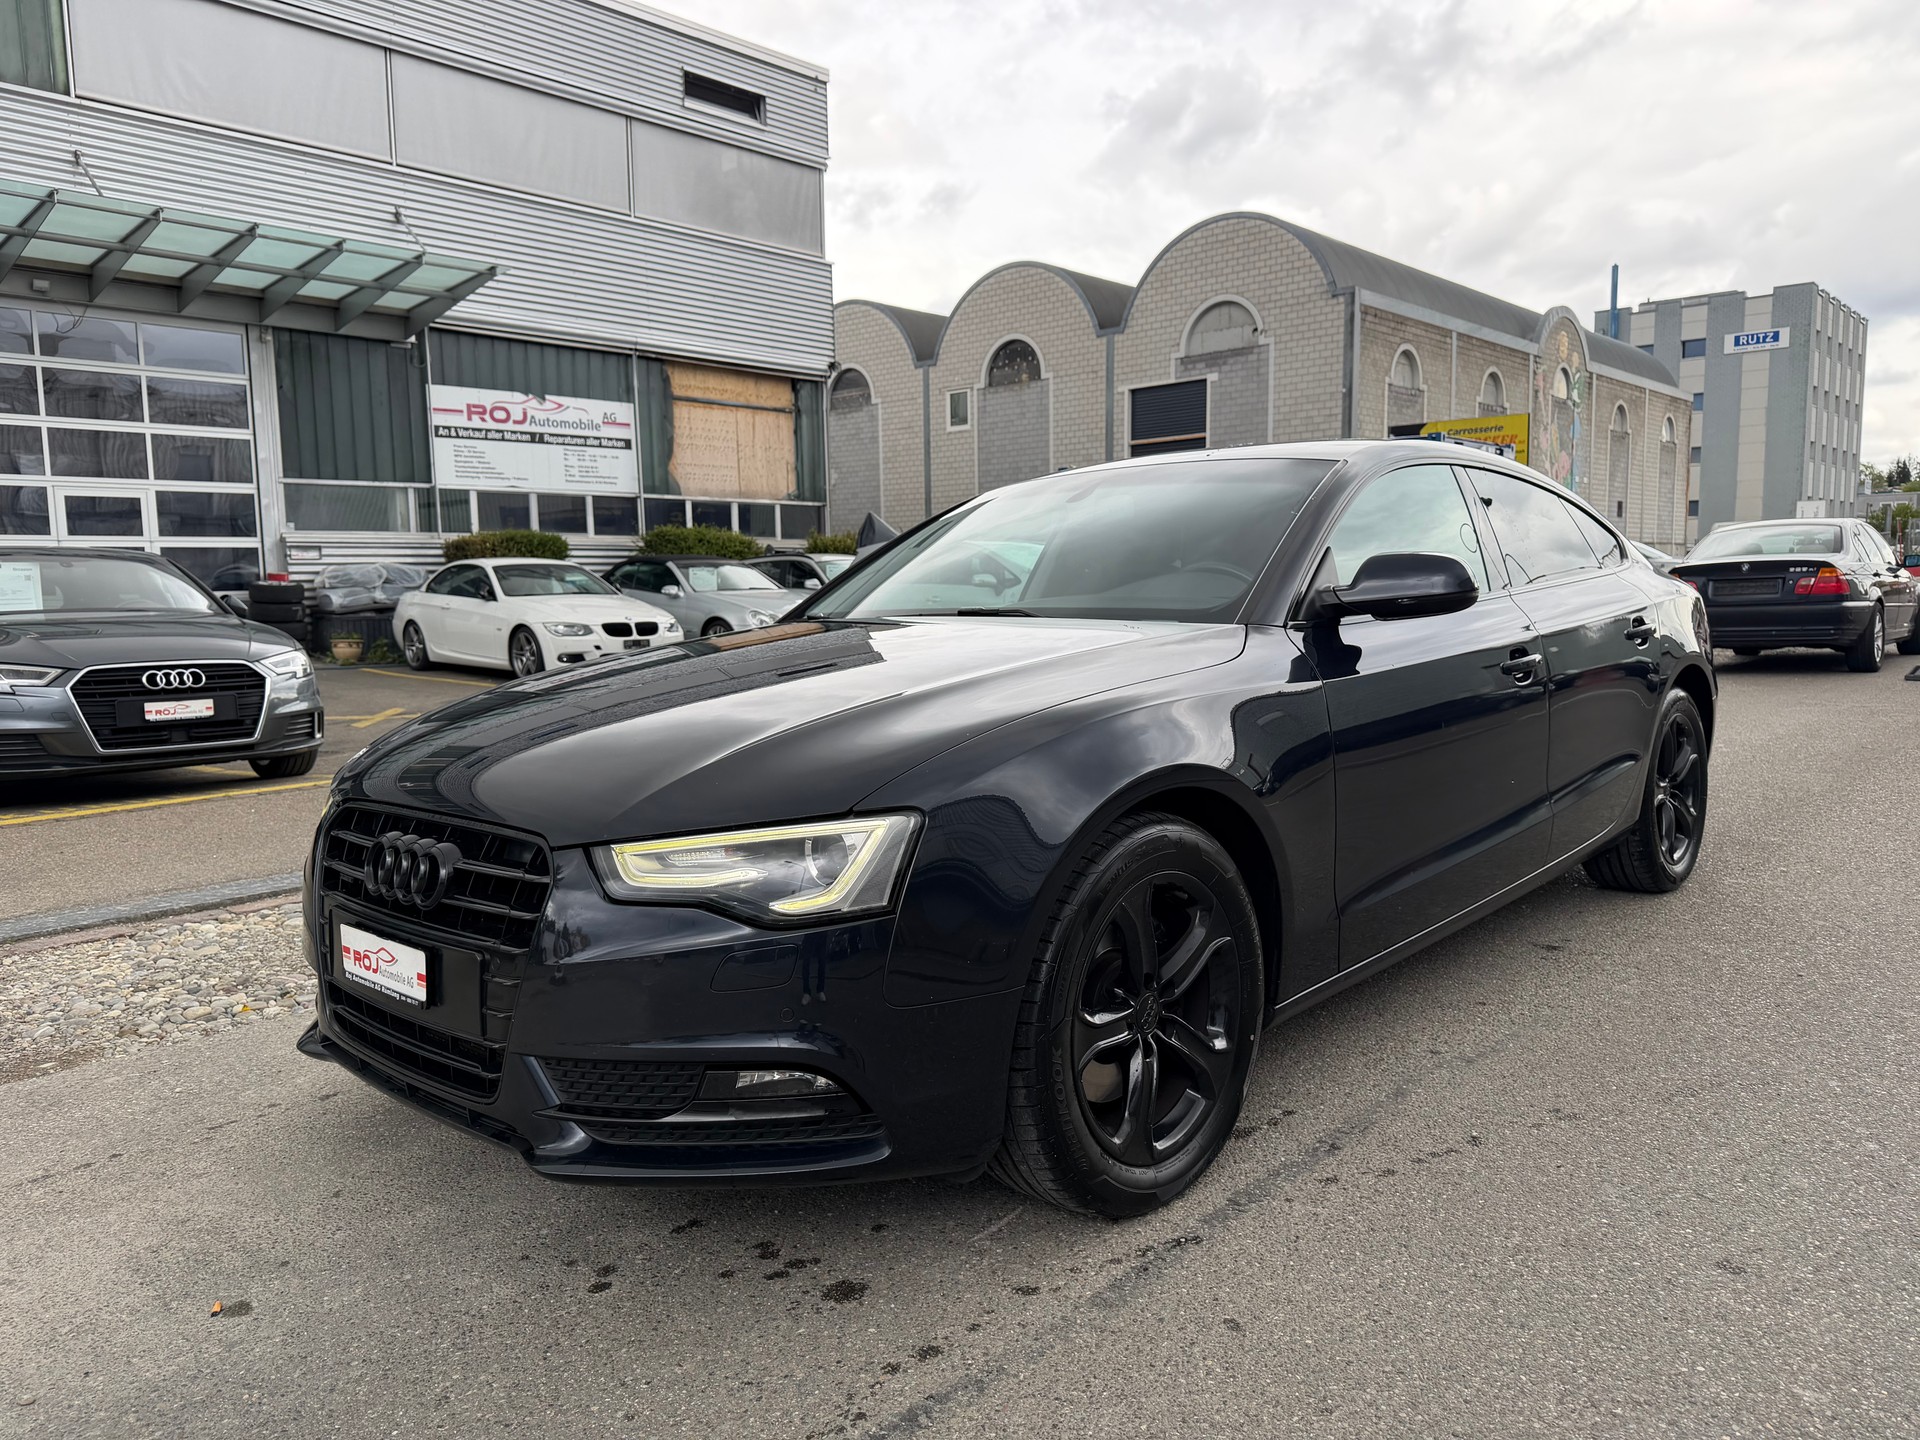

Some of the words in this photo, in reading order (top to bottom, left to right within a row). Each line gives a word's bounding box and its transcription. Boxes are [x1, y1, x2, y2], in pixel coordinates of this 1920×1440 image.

[1740, 332, 1774, 345] RUTZ
[466, 403, 528, 425] ROJ
[529, 415, 601, 431] Automobile
[602, 412, 617, 422] AG
[438, 427, 449, 436] An
[450, 428, 456, 437] &
[457, 428, 486, 439] Verkauf
[487, 430, 503, 440] aller
[504, 431, 531, 442] Marken
[544, 434, 585, 446] Reparaturen
[586, 437, 600, 446] aller
[601, 438, 626, 448] Marken
[1447, 424, 1504, 436] Carrosserie
[155, 708, 177, 716] ROJ
[353, 949, 379, 974] ROJ
[379, 966, 406, 986] Automobile
[406, 973, 414, 989] AG
[353, 975, 374, 989] Automobile
[375, 984, 381, 992] AG
